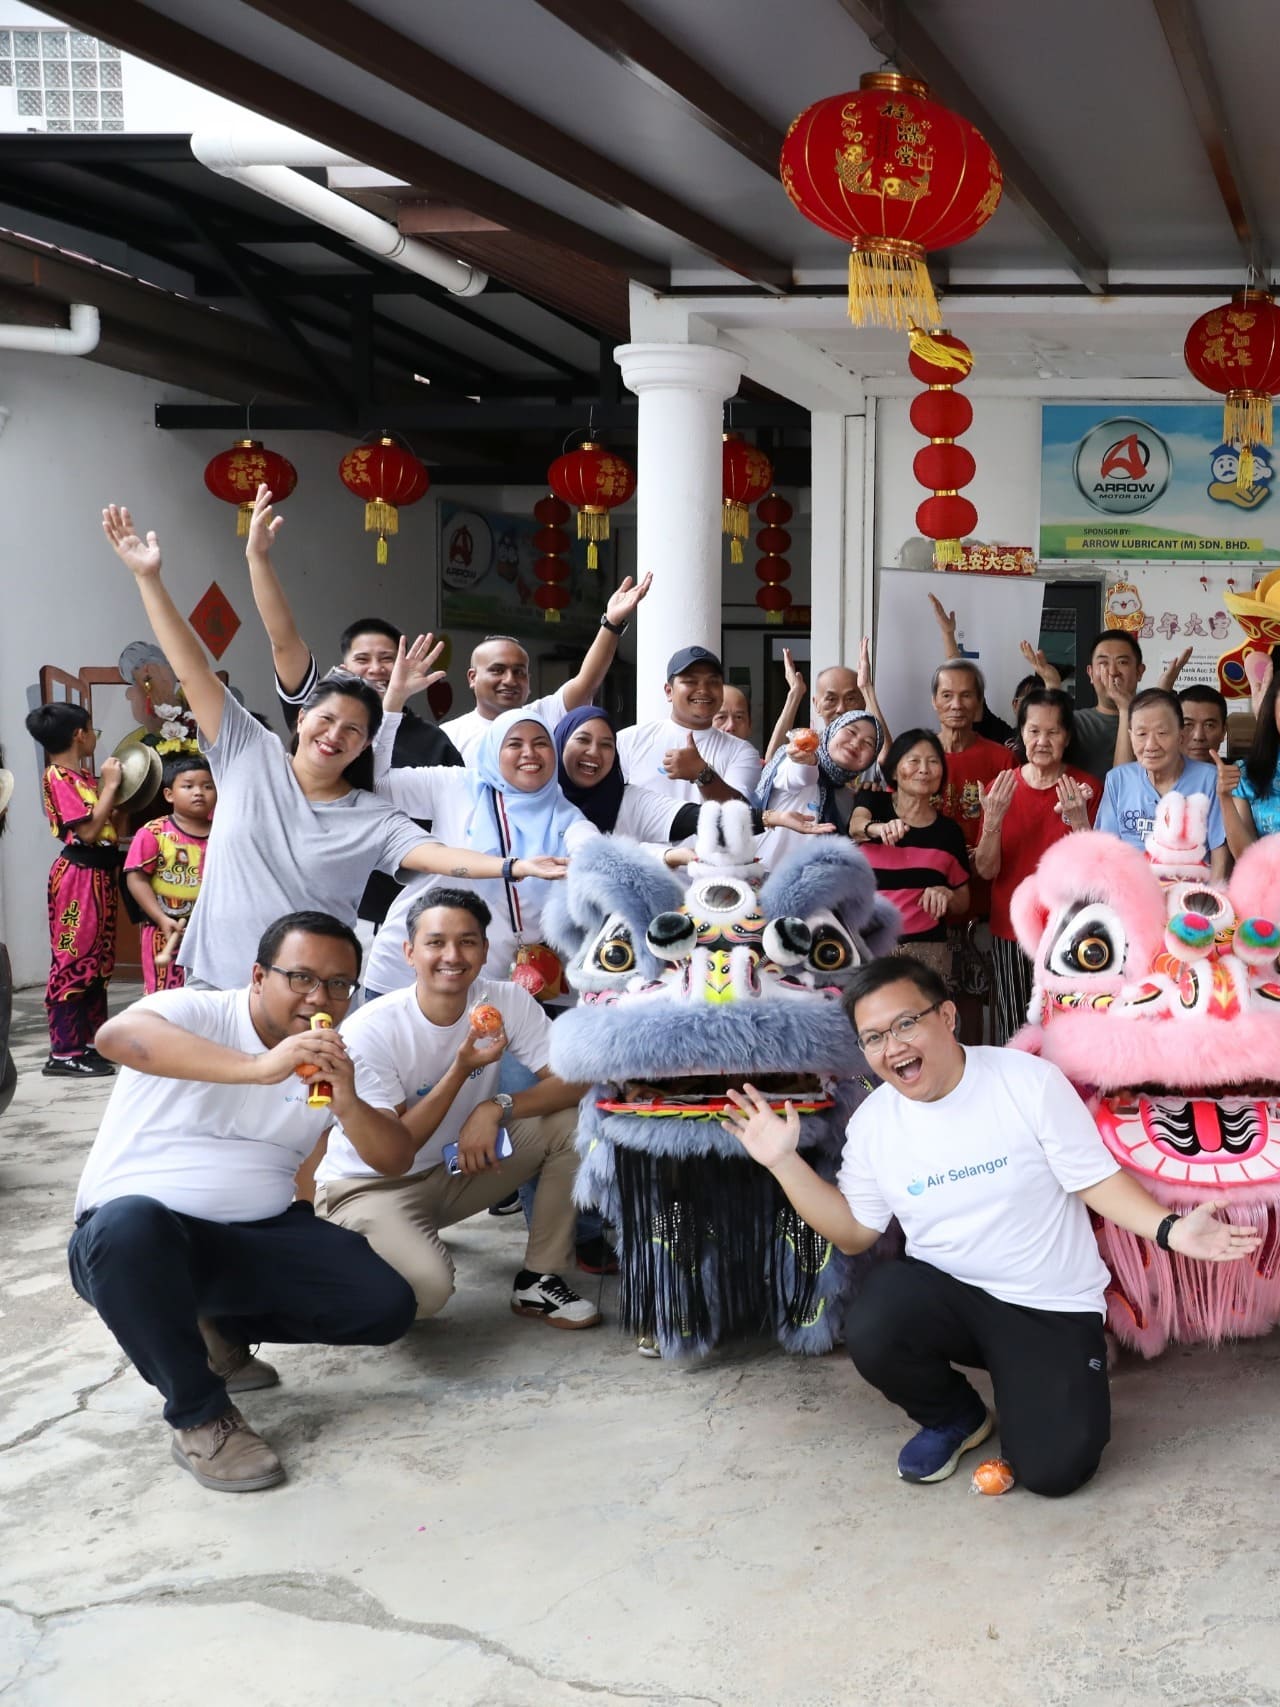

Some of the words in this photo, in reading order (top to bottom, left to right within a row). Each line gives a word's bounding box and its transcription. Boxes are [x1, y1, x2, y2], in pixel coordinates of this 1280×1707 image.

[1093, 483, 1156, 493] ARROW
[1083, 528, 1119, 536] SPONSOR
[1119, 528, 1131, 536] BY:
[1082, 539, 1120, 549] ARROW
[1121, 539, 1179, 549] LUBRICANT
[1180, 540, 1197, 550] (M)
[1199, 540, 1223, 550] SDN.
[1225, 541, 1251, 550] BHD.
[927, 1173, 945, 1188] Air
[947, 1155, 1008, 1182] Selangor
